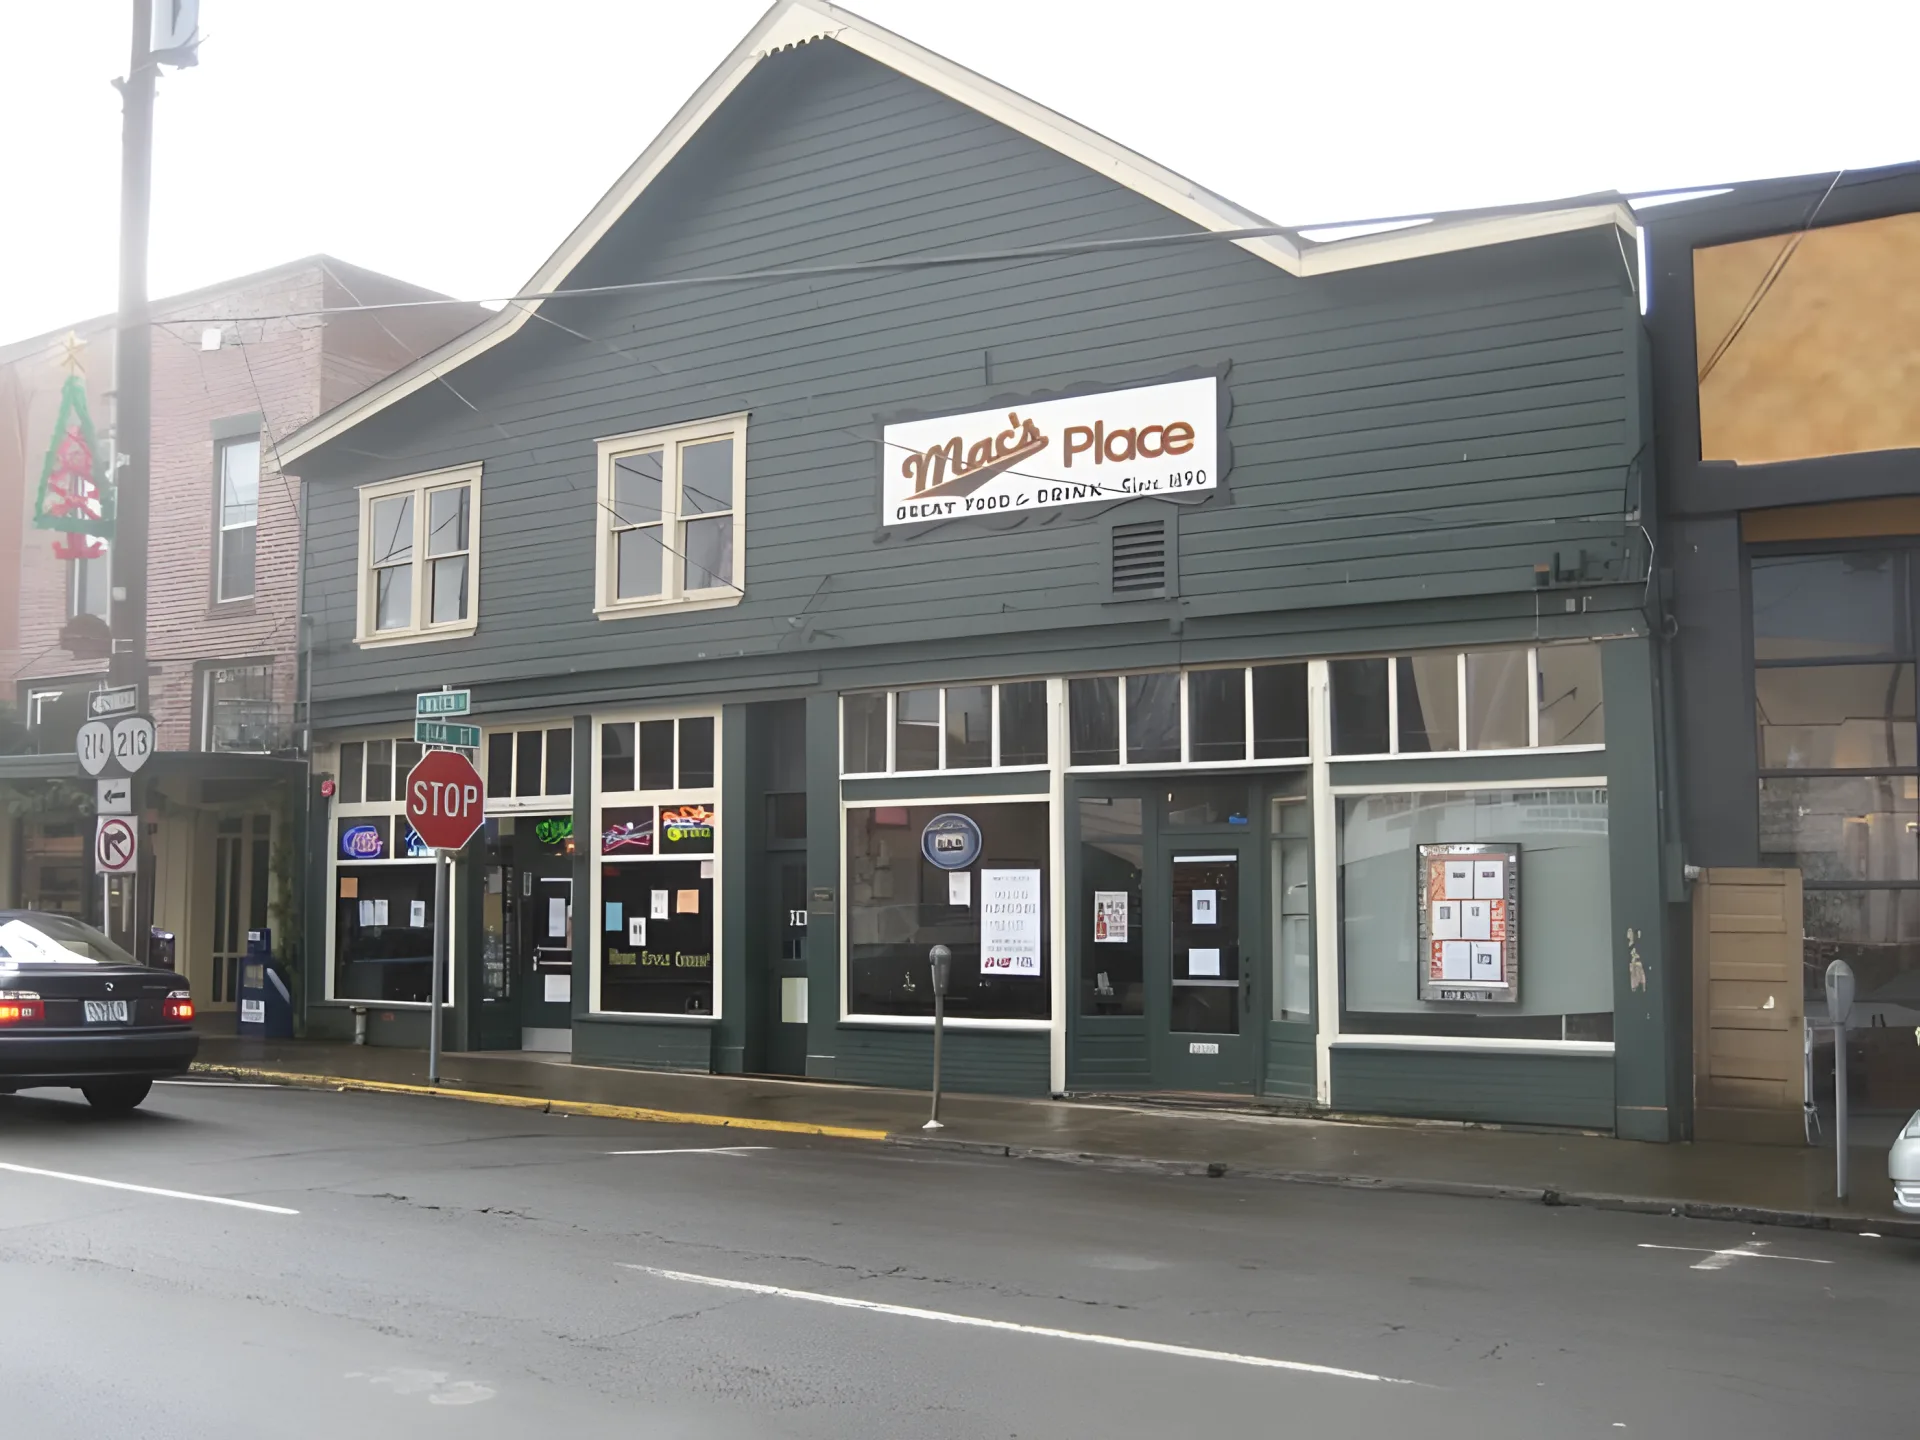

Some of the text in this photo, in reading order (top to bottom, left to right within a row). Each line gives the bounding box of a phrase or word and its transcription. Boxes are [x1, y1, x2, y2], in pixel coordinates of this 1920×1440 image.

[902, 412, 1195, 494] Mac's Place
[412, 780, 478, 817] STOP
